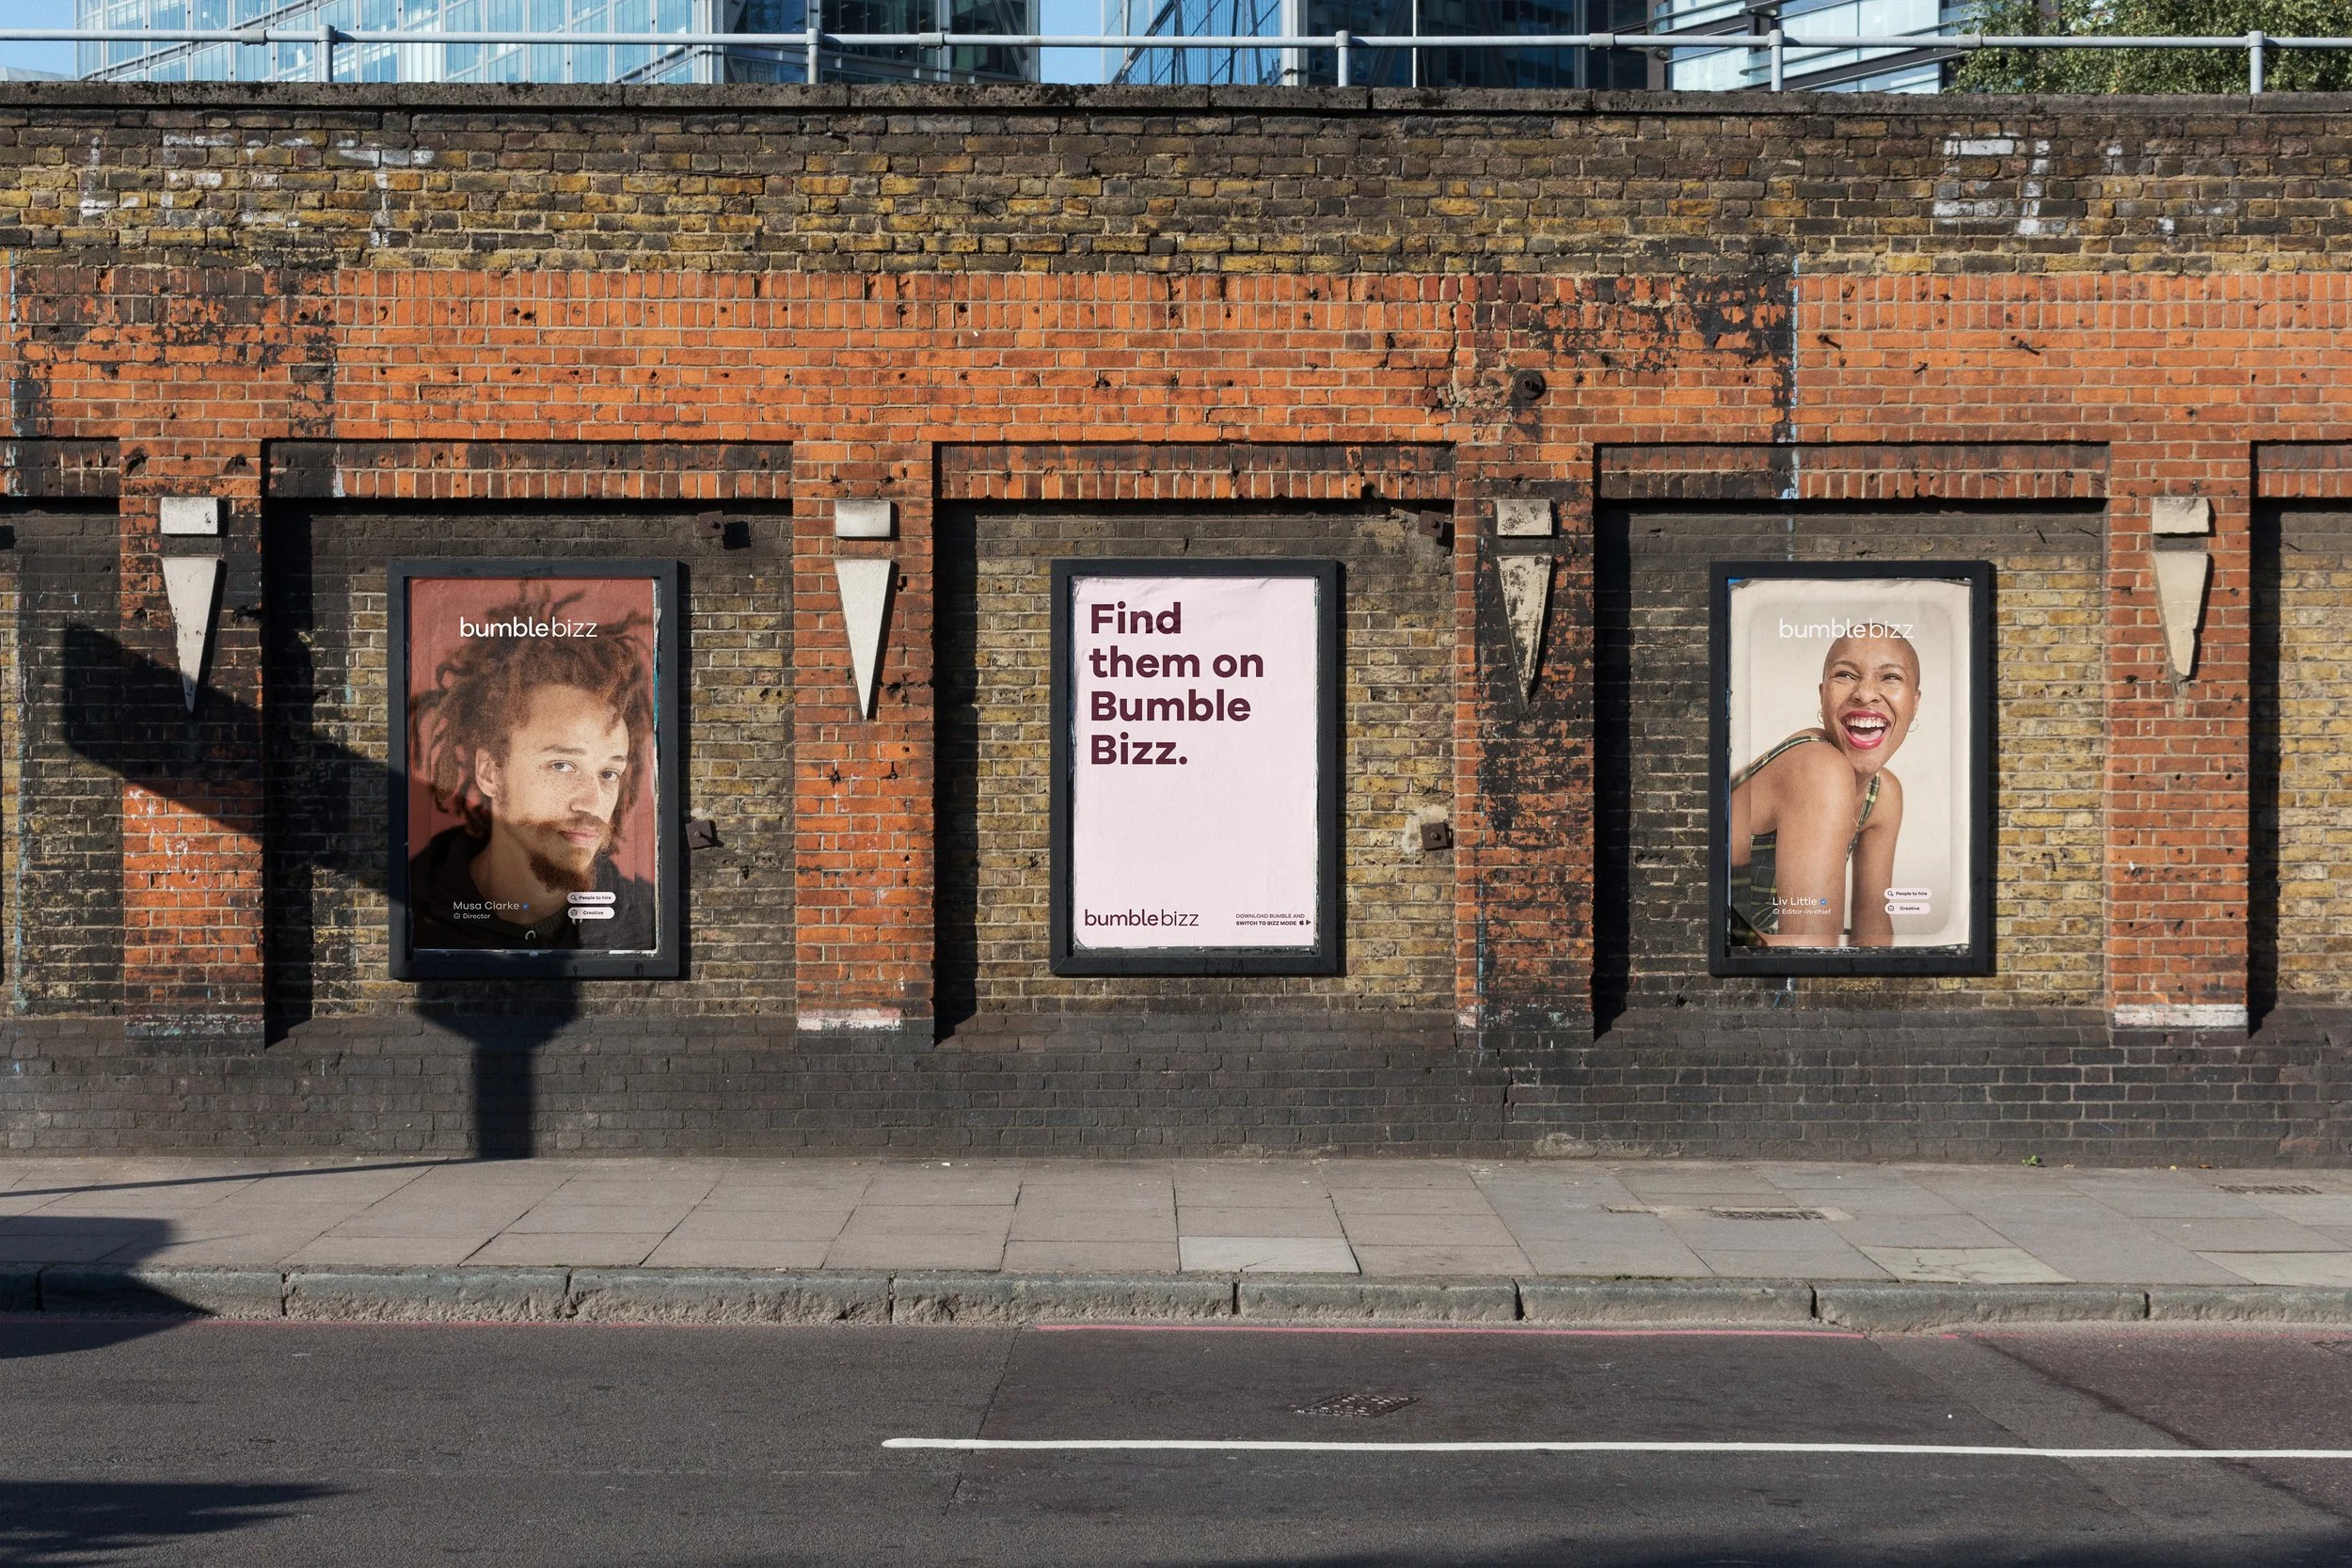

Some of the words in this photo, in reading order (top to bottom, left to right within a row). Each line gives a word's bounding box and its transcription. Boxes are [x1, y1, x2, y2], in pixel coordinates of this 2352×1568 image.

[1091, 600, 1181, 634] Find
[1089, 645, 1200, 678] them
[1213, 654, 1263, 678] on
[1091, 689, 1251, 721] Bumble
[1091, 732, 1187, 765] Bizz.
[453, 901, 482, 910] Musa
[485, 900, 519, 910] Clarke
[1790, 896, 1818, 905] Little
